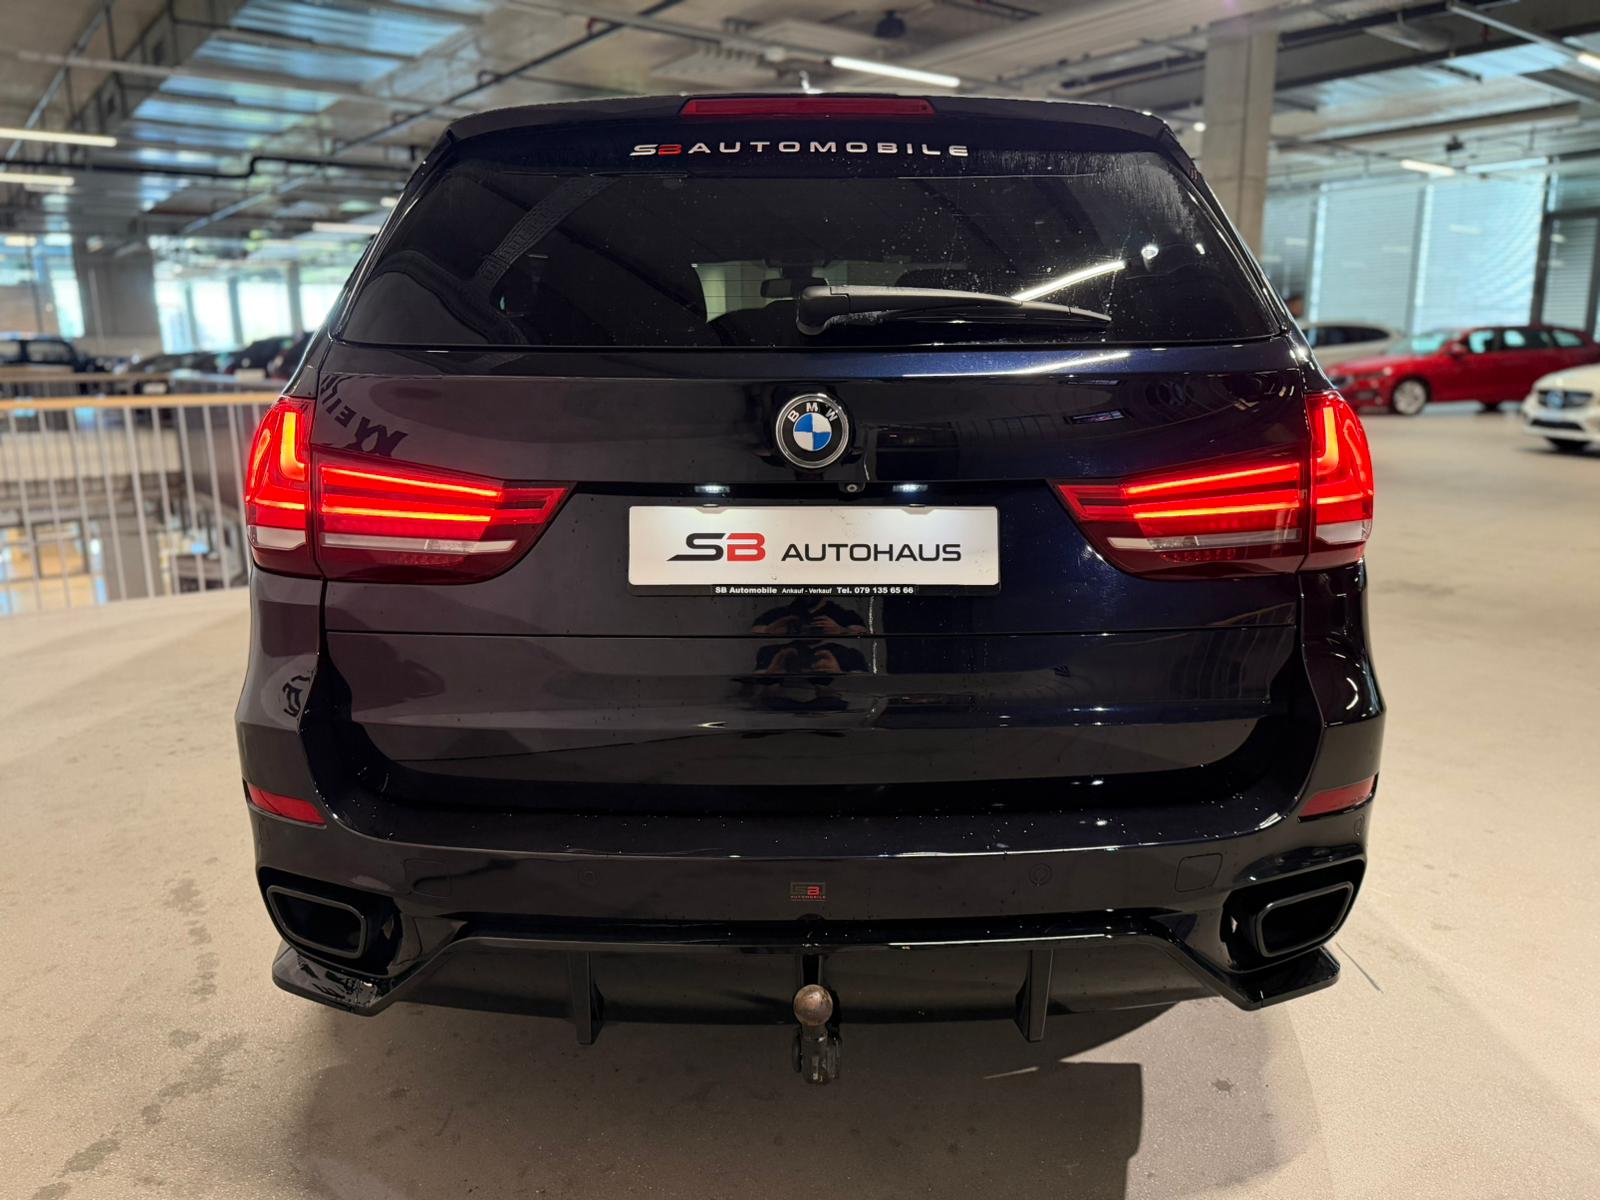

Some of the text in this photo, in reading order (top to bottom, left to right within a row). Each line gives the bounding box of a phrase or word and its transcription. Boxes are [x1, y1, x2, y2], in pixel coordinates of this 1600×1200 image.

[688, 141, 969, 157] AUTOMOBILE
[787, 402, 838, 422] BMW
[666, 532, 962, 562] SB AUTOHAUS
[715, 586, 728, 594] SB
[729, 586, 778, 594] Automobile
[837, 586, 852, 594] Tel.
[854, 586, 870, 594] 079
[872, 586, 888, 594] 135
[890, 586, 901, 594] 65
[903, 586, 914, 594] 66
